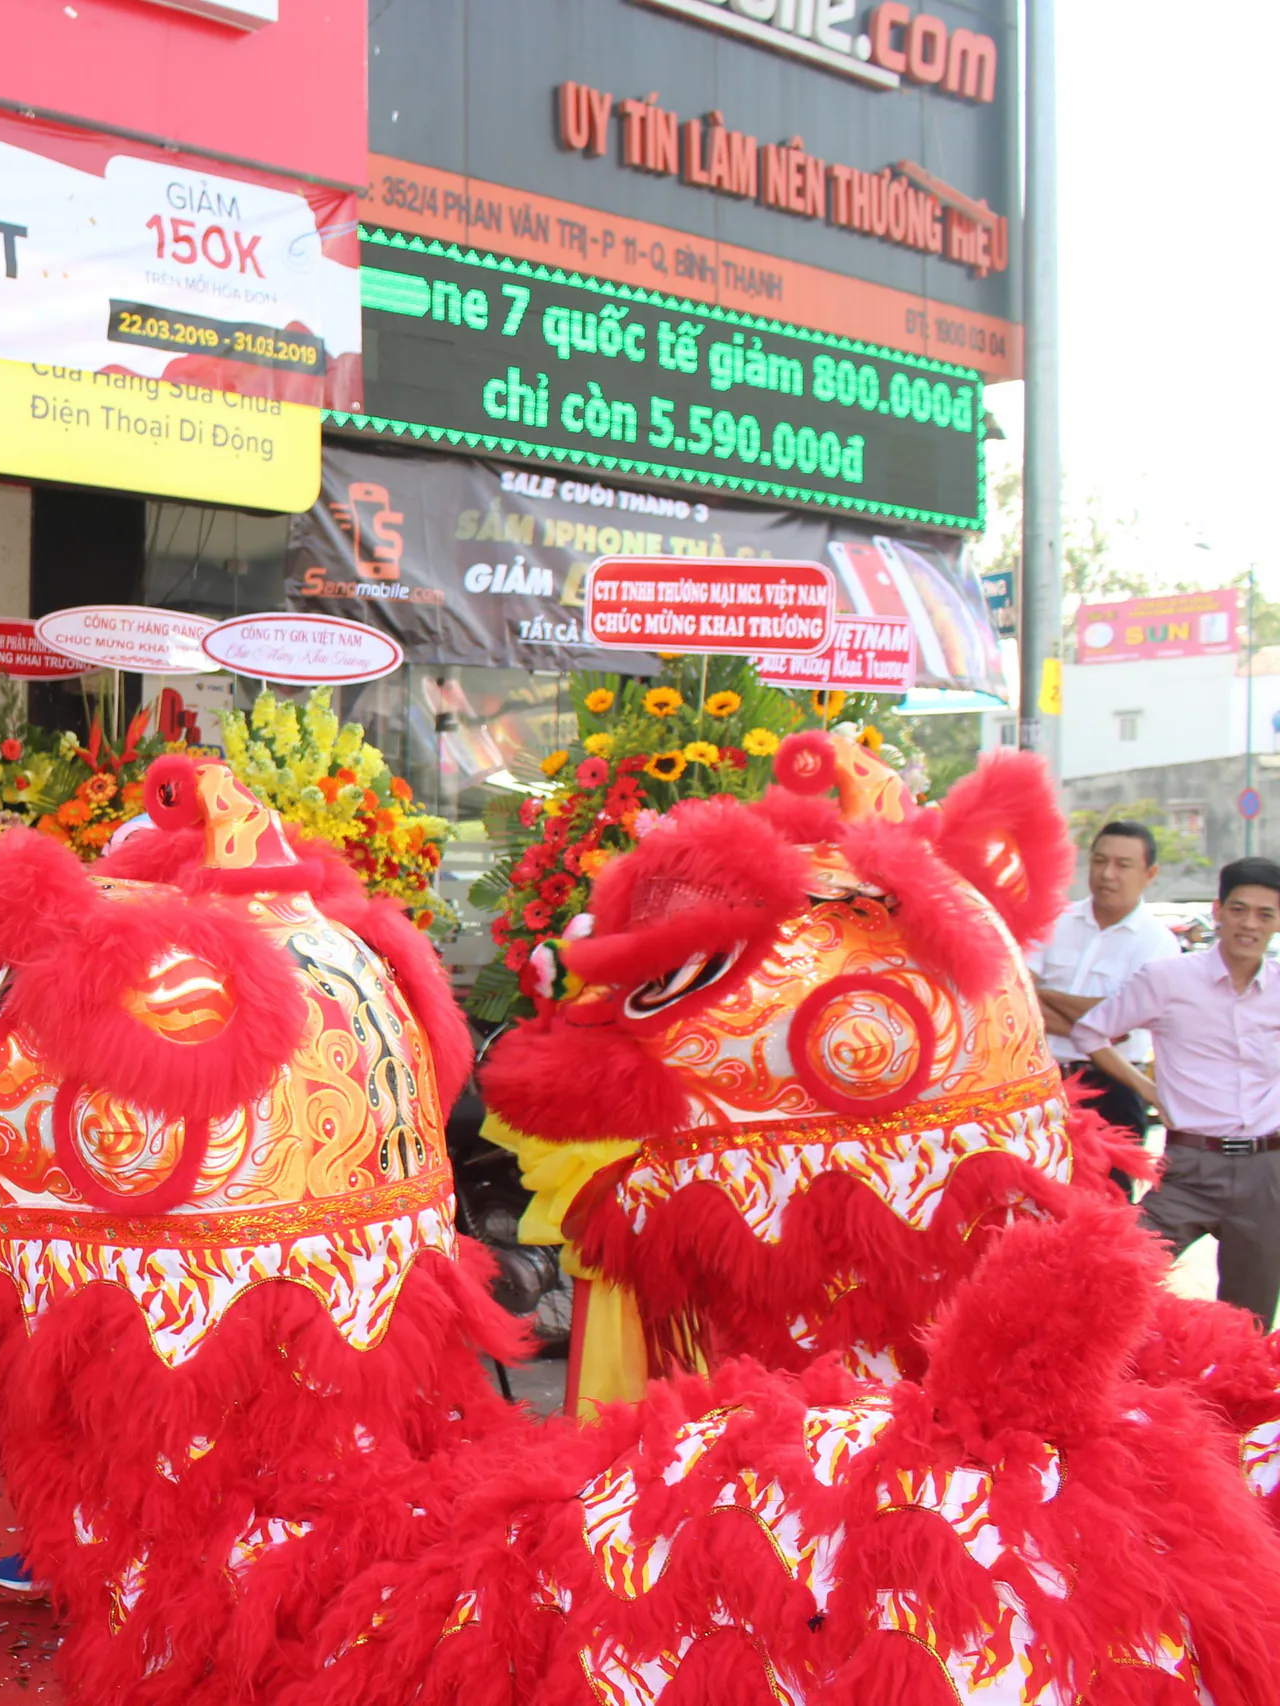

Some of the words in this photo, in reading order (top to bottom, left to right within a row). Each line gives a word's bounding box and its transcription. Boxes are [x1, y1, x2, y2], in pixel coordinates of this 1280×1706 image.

[560, 79, 613, 157] UY
[620, 90, 679, 175] TÍN
[684, 110, 758, 199] LÀM
[763, 135, 826, 219] NÊN
[828, 164, 943, 255] THƯƠNG
[166, 179, 241, 221] GIẢM
[382, 175, 439, 218] 352/4
[443, 190, 502, 234] PHAN
[509, 202, 550, 244] VĂN
[145, 213, 267, 279] 150K
[118, 312, 218, 348] 22.03.2019
[233, 331, 318, 366] 31.03.2019
[501, 283, 531, 336] 7
[542, 303, 646, 360] quốc
[708, 332, 804, 396] giảm
[812, 354, 974, 434] 800.000đ
[30, 394, 91, 432] Điện
[101, 405, 170, 446] Thoại
[179, 418, 204, 444] Di
[211, 424, 274, 461] Động
[482, 366, 550, 428] chỉ
[560, 381, 638, 444] còn
[648, 396, 865, 484] 5.590.000đ
[500, 470, 557, 500] SALE
[693, 503, 710, 523] 3
[464, 555, 554, 597] GIẢM
[594, 580, 619, 601] CTY
[621, 580, 656, 602] TNHH
[765, 579, 796, 611] VIỆT
[797, 584, 828, 607] NAM
[56, 633, 91, 646] CHÚC
[84, 613, 117, 630] CÔNG
[121, 619, 135, 632] TY
[241, 624, 270, 641] CÔNG
[274, 628, 287, 642] TY
[312, 627, 337, 646] VIỆT
[339, 633, 363, 647] NAM
[594, 607, 642, 634] CHÚC
[698, 615, 745, 637] KHAI
[748, 612, 824, 639] TRƯƠNG
[1125, 621, 1191, 646] SUN
[16, 653, 42, 667] KHAI
